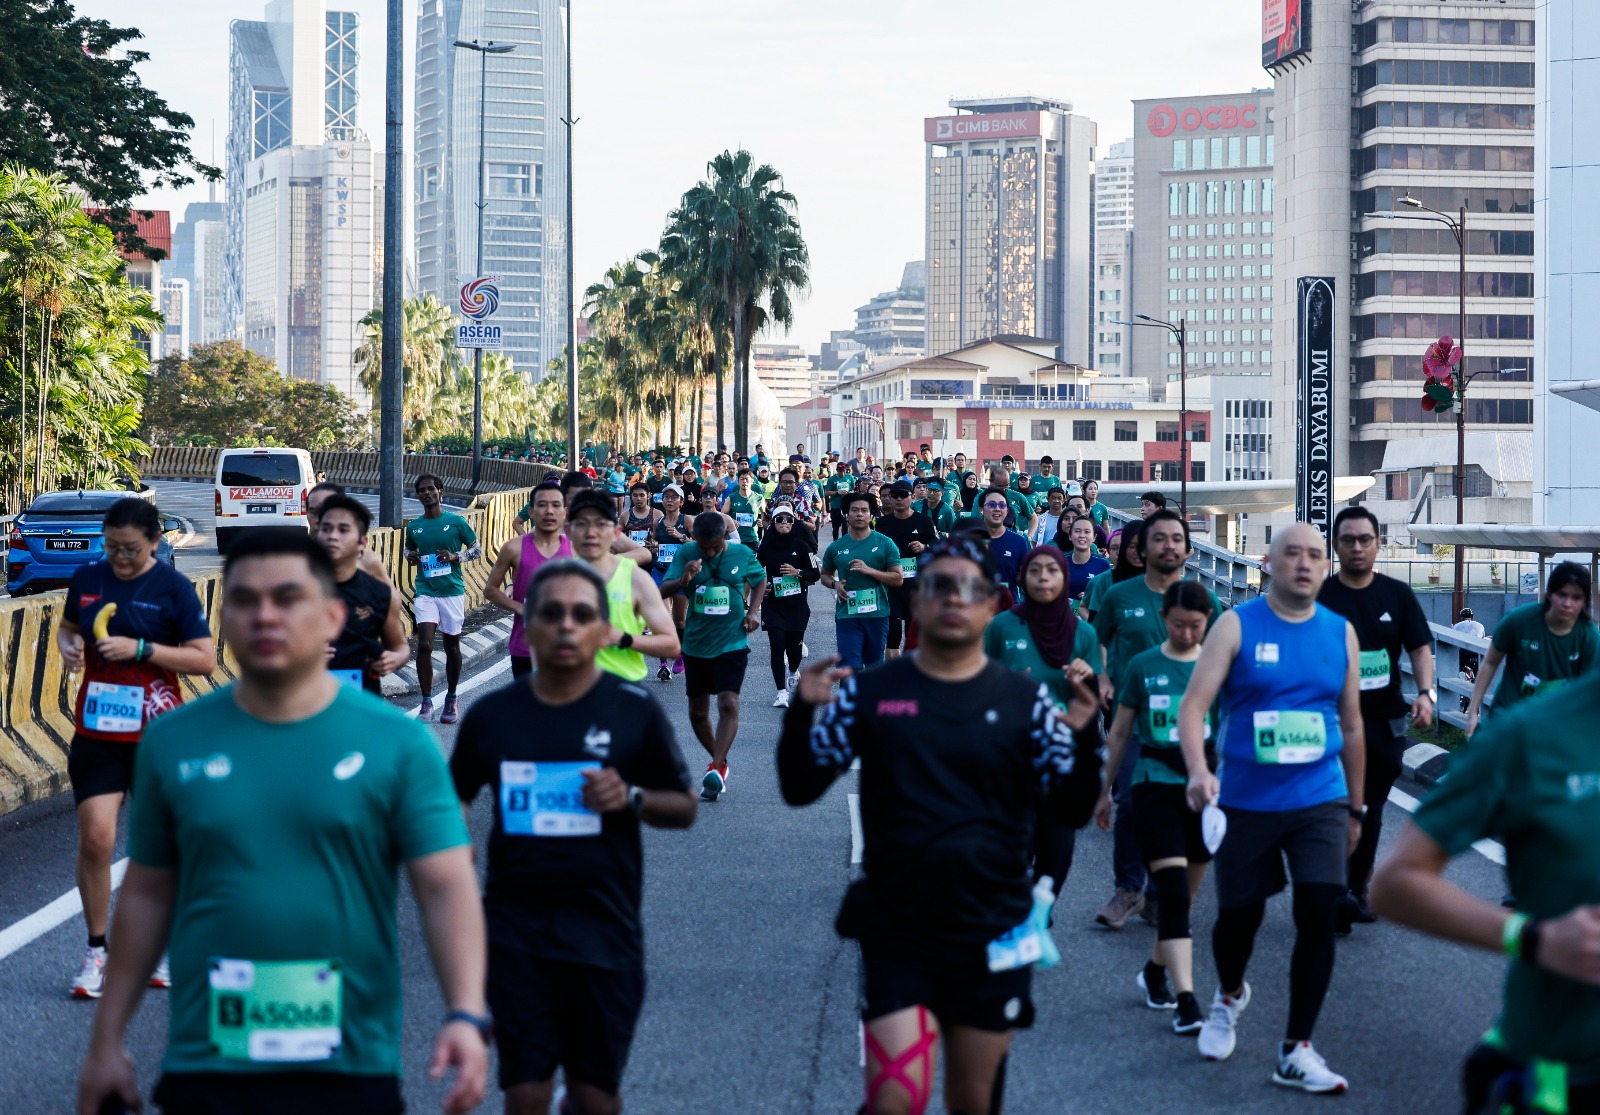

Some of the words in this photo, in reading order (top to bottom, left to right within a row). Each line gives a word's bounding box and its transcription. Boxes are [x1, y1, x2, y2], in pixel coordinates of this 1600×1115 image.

[1180, 104, 1257, 132] OCBC
[955, 120, 990, 134] CIMB
[991, 118, 1028, 132] BANK
[336, 177, 349, 228] KWSP
[459, 325, 501, 338] ASEAN
[964, 400, 998, 409] WISMA
[1000, 400, 1035, 409] BADAN
[1038, 401, 1081, 410] PEGUAM
[1084, 401, 1134, 411] MALAYSIA
[1311, 348, 1329, 462] DAYABUMI
[240, 487, 293, 497] LALAMOVE
[1310, 469, 1328, 546] PLEKS
[704, 597, 728, 606] 44893
[100, 703, 137, 718] 17502
